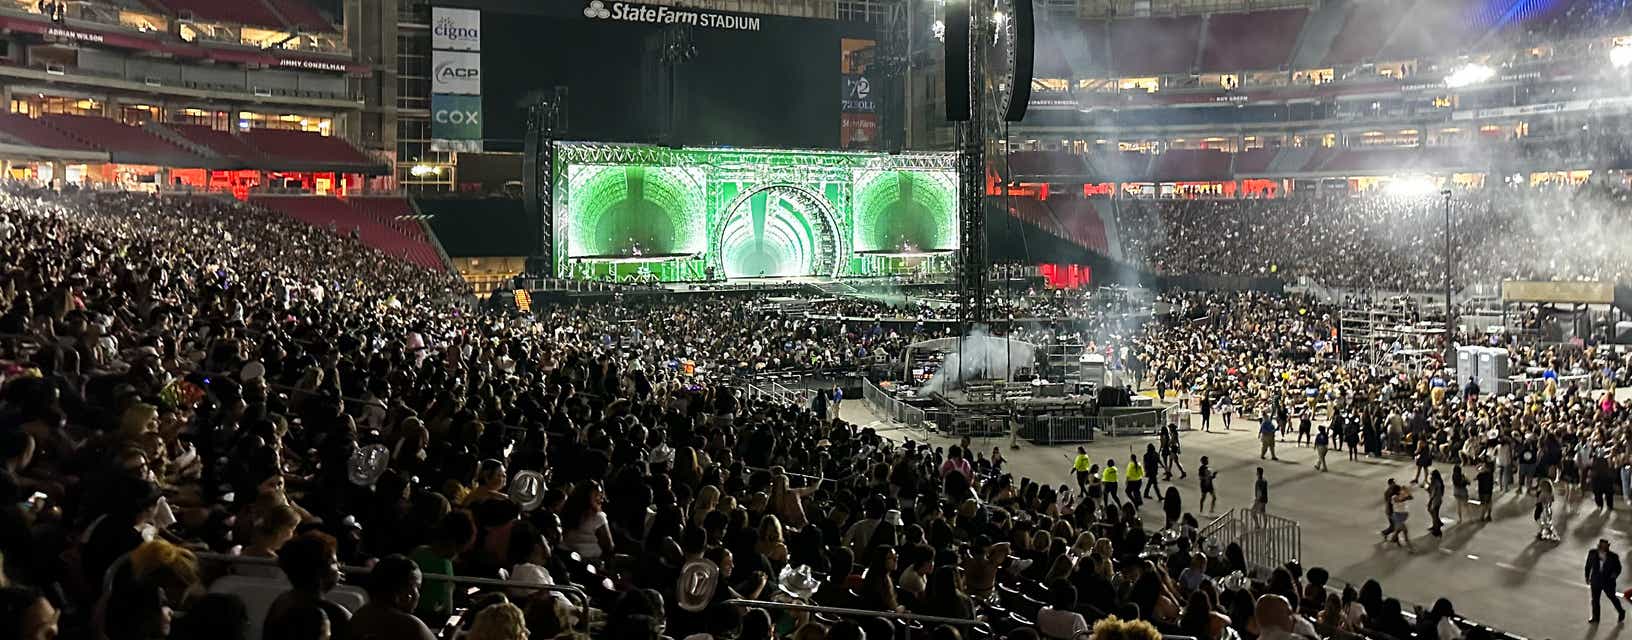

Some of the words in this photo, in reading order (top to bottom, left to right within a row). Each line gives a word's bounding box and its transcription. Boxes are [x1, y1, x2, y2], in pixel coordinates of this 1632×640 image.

[700, 13, 760, 31] STADIUM
[48, 28, 76, 38] ADRIAN
[76, 32, 104, 42] WILSON
[434, 23, 478, 40] cigna
[280, 59, 301, 67] JIMMY
[303, 61, 346, 71] CONZELMAN
[442, 67, 479, 77] ACP
[436, 110, 478, 125] COX
